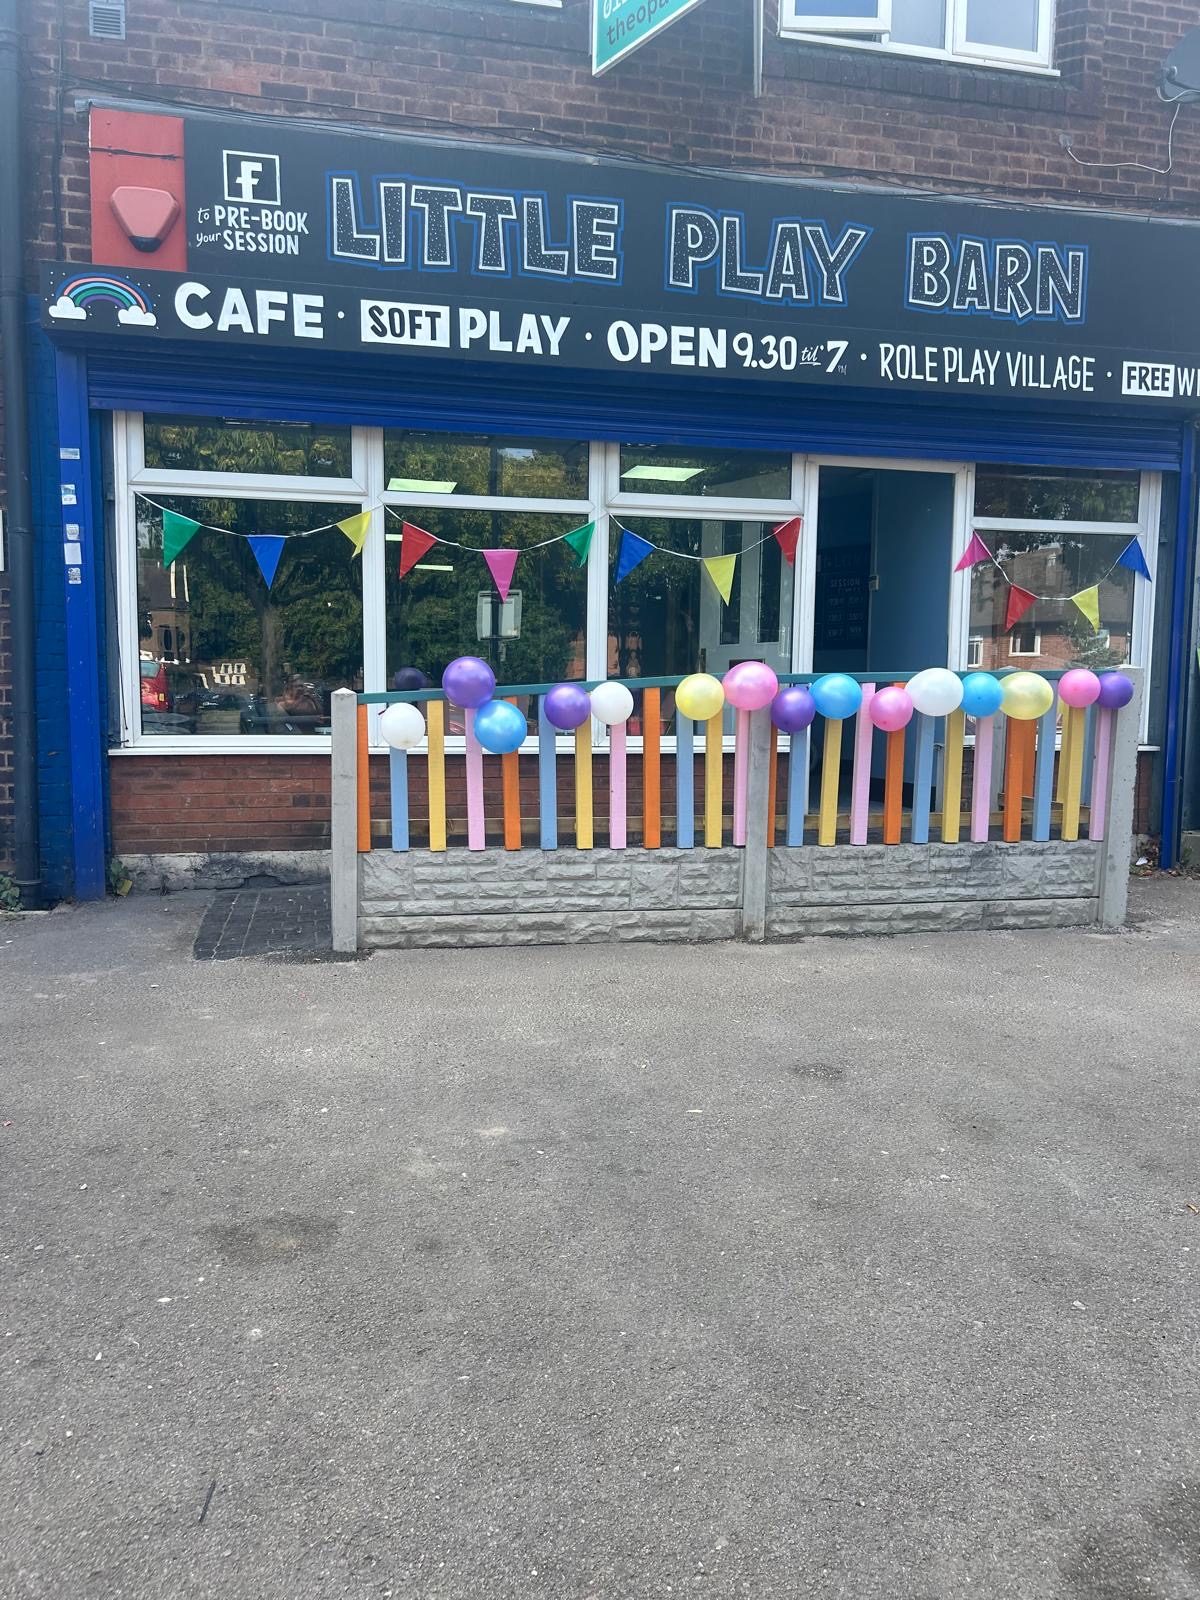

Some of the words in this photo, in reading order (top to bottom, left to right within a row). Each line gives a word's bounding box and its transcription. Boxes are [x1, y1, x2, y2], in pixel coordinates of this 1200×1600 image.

[196, 232, 222, 248] your
[223, 229, 299, 255] SESSION
[197, 207, 210, 224] to
[213, 205, 309, 234] PRE-BOOK
[330, 175, 621, 281] LITTLE
[667, 207, 868, 304] PLAY
[907, 236, 1085, 320] BARN
[174, 281, 325, 339] CAFE
[368, 303, 443, 342] SOFT
[458, 306, 571, 356] PLAY
[606, 320, 727, 368] OPEN
[732, 332, 798, 371] 9.30
[825, 340, 850, 373] 7
[879, 342, 938, 382] ROLE
[944, 345, 1002, 387] PLAY
[1006, 350, 1096, 392] VILLAGE
[1126, 365, 1172, 393] FREE
